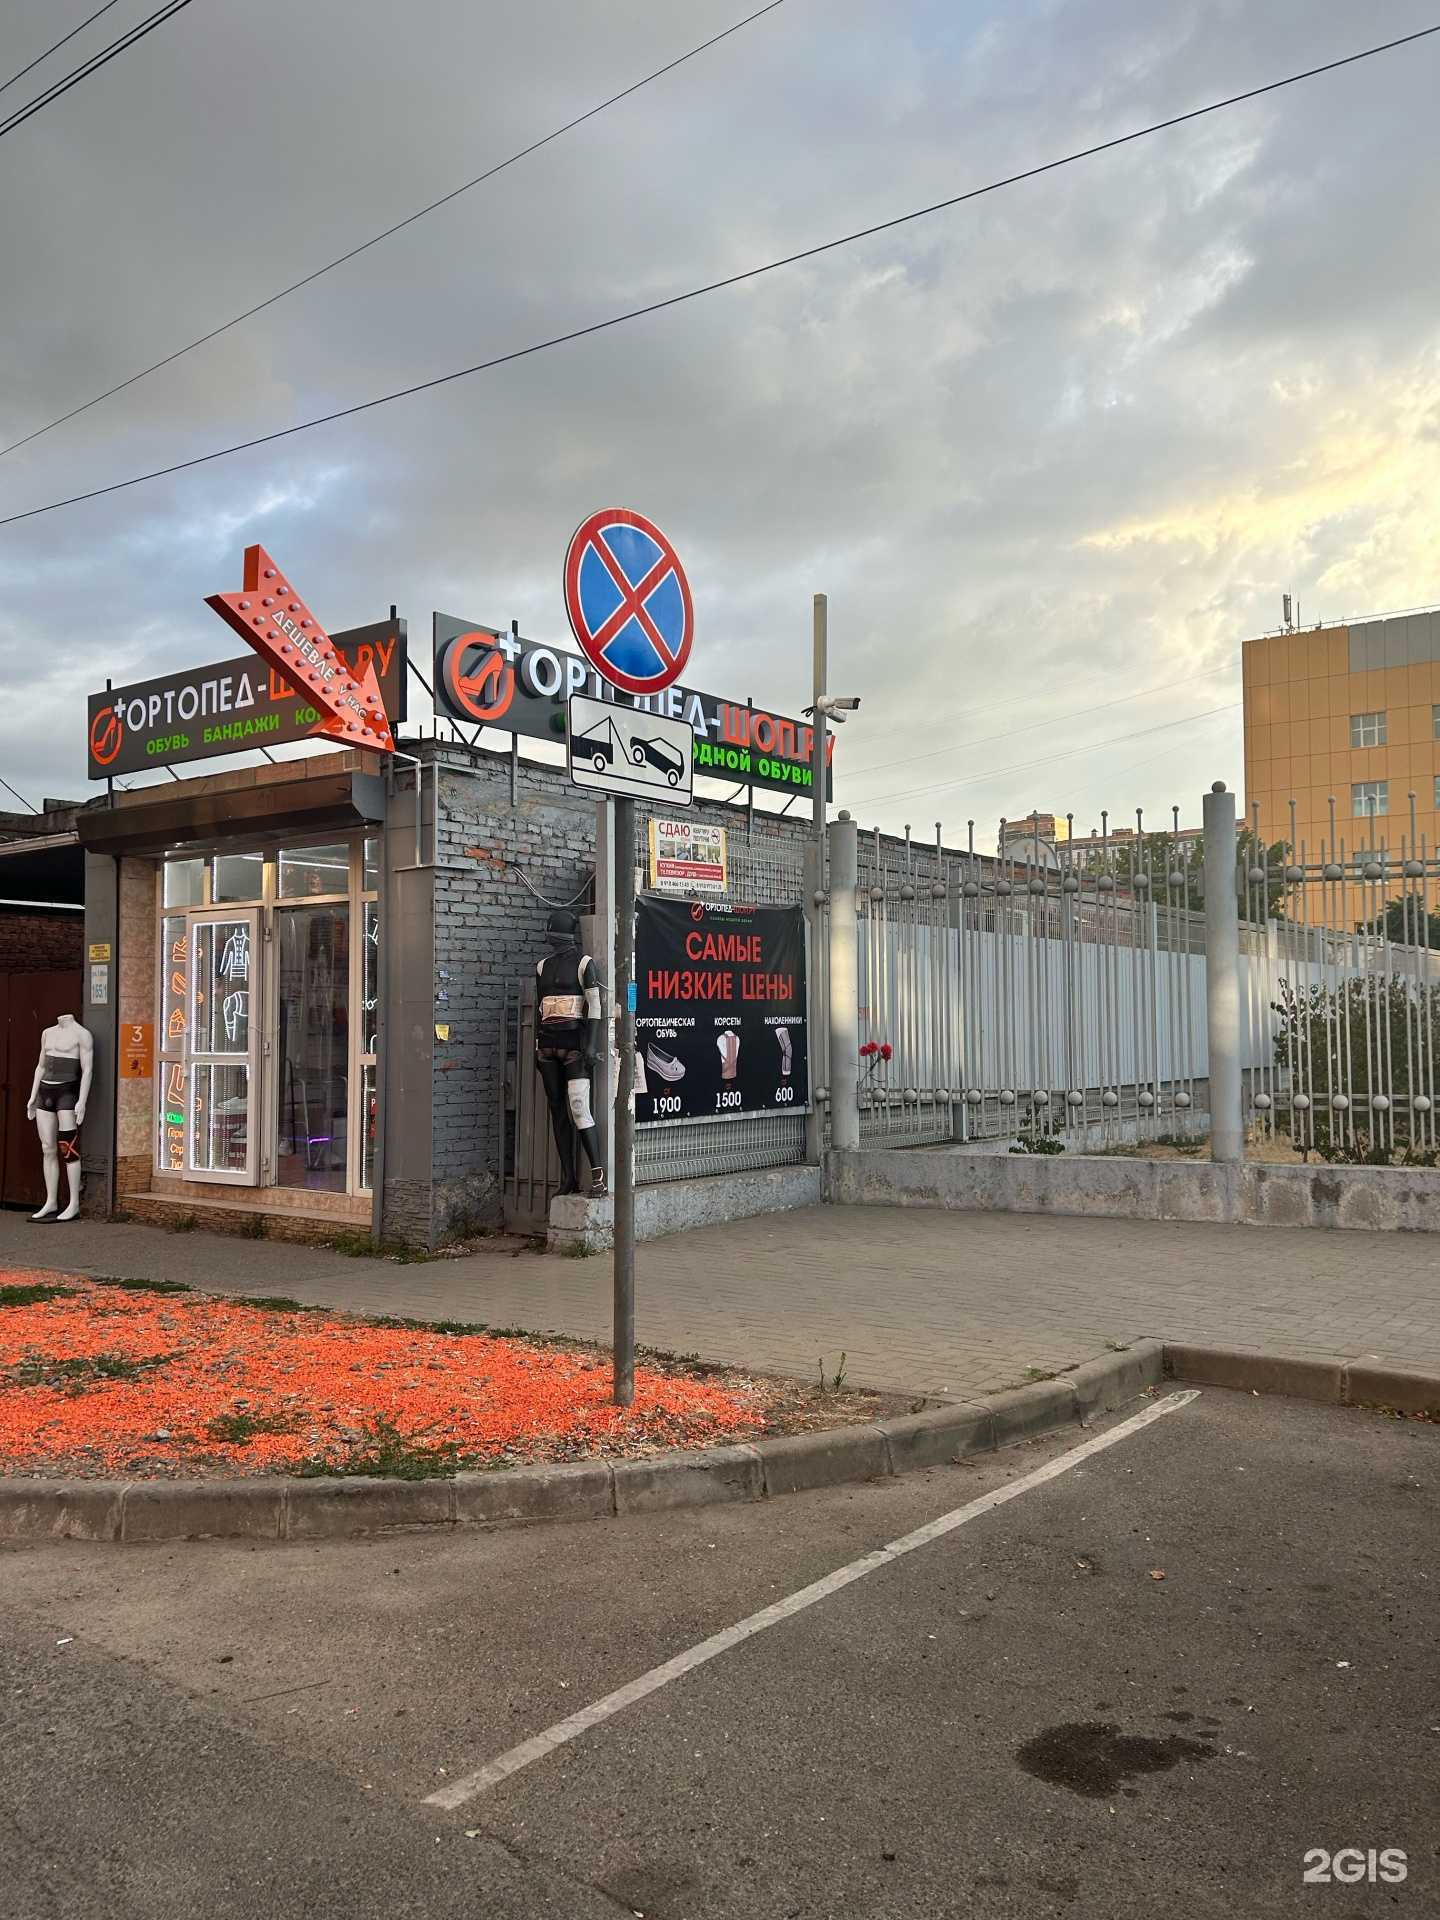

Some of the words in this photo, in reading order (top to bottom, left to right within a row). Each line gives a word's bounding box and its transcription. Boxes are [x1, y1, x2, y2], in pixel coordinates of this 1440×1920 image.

[272, 610, 336, 682] ДЕШЕВЛЕ
[146, 733, 190, 755] ОБУВЬ
[203, 714, 280, 743] БАНДАЖИ
[759, 758, 812, 786] ОБУВИ
[658, 822, 690, 838] СДАЮ
[685, 931, 762, 963] САМЫЕ
[648, 970, 733, 1000] НИЗКИЕ
[742, 973, 793, 1000] ЦЕНЫ
[636, 1017, 696, 1027] ОРТОПЕДИЧЕСКАЯ
[714, 1017, 742, 1026] КОРСЕТЫ
[131, 1026, 143, 1042] 3
[656, 1028, 677, 1038] ОБУВЬ
[715, 1091, 741, 1107] 1500
[775, 1087, 793, 1102] 600
[653, 1096, 681, 1114] 1900
